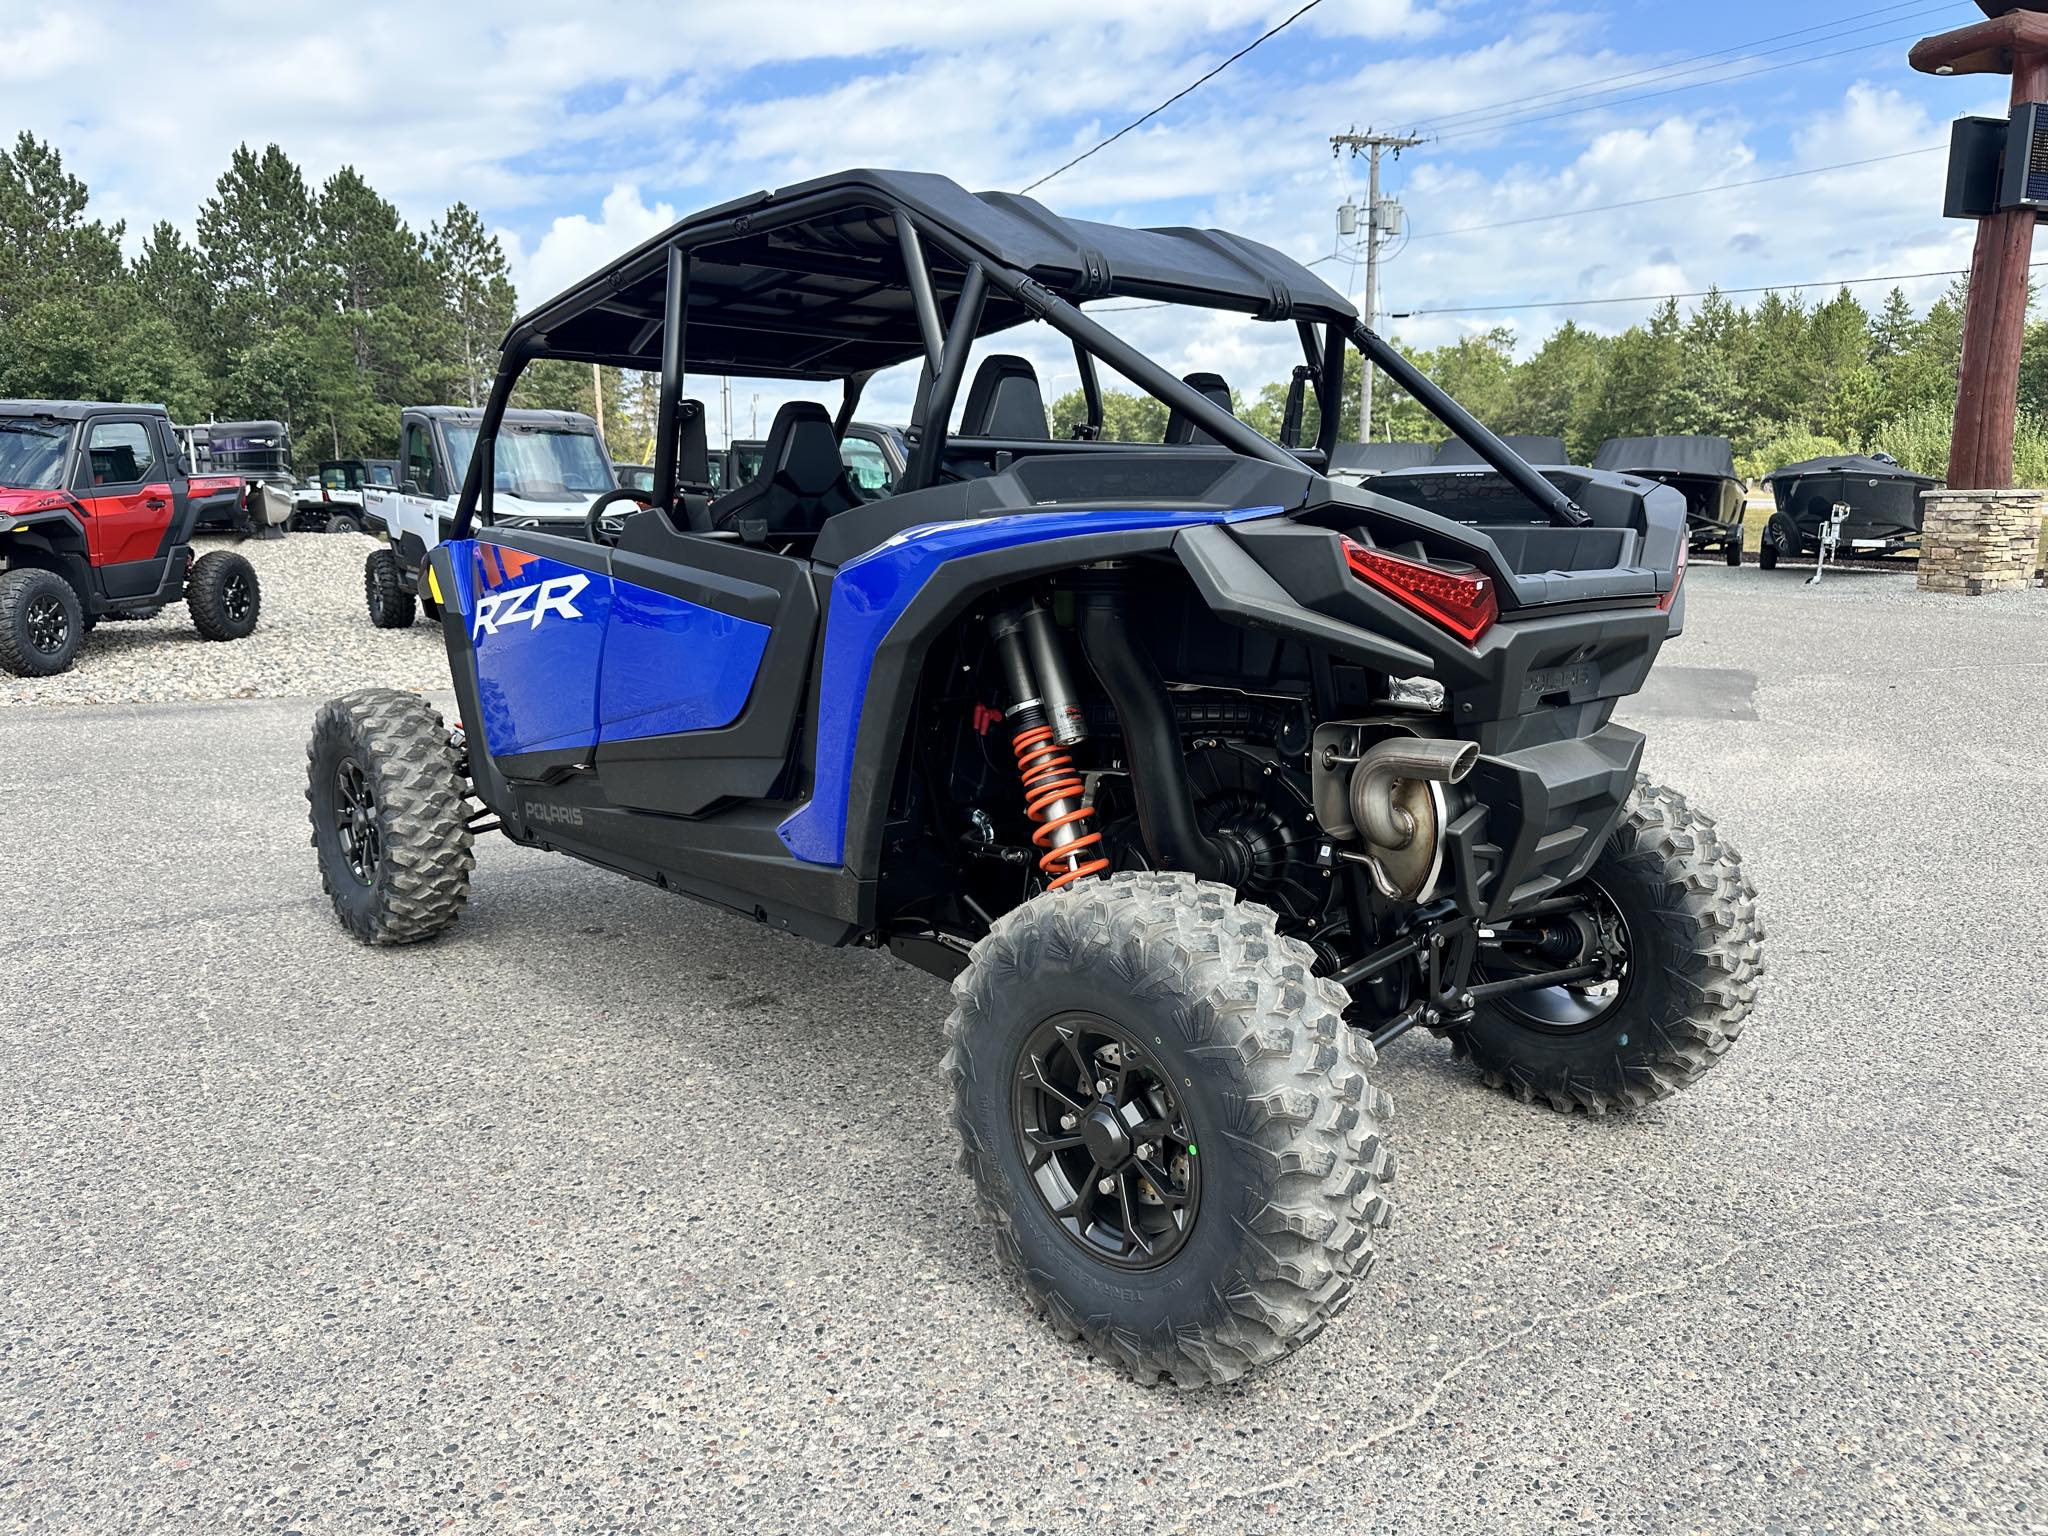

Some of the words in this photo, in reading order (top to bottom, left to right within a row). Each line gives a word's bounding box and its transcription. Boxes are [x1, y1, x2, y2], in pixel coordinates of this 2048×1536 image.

[39, 498, 55, 507] XP
[473, 573, 591, 642] RZR
[525, 801, 583, 826] POLARIS
